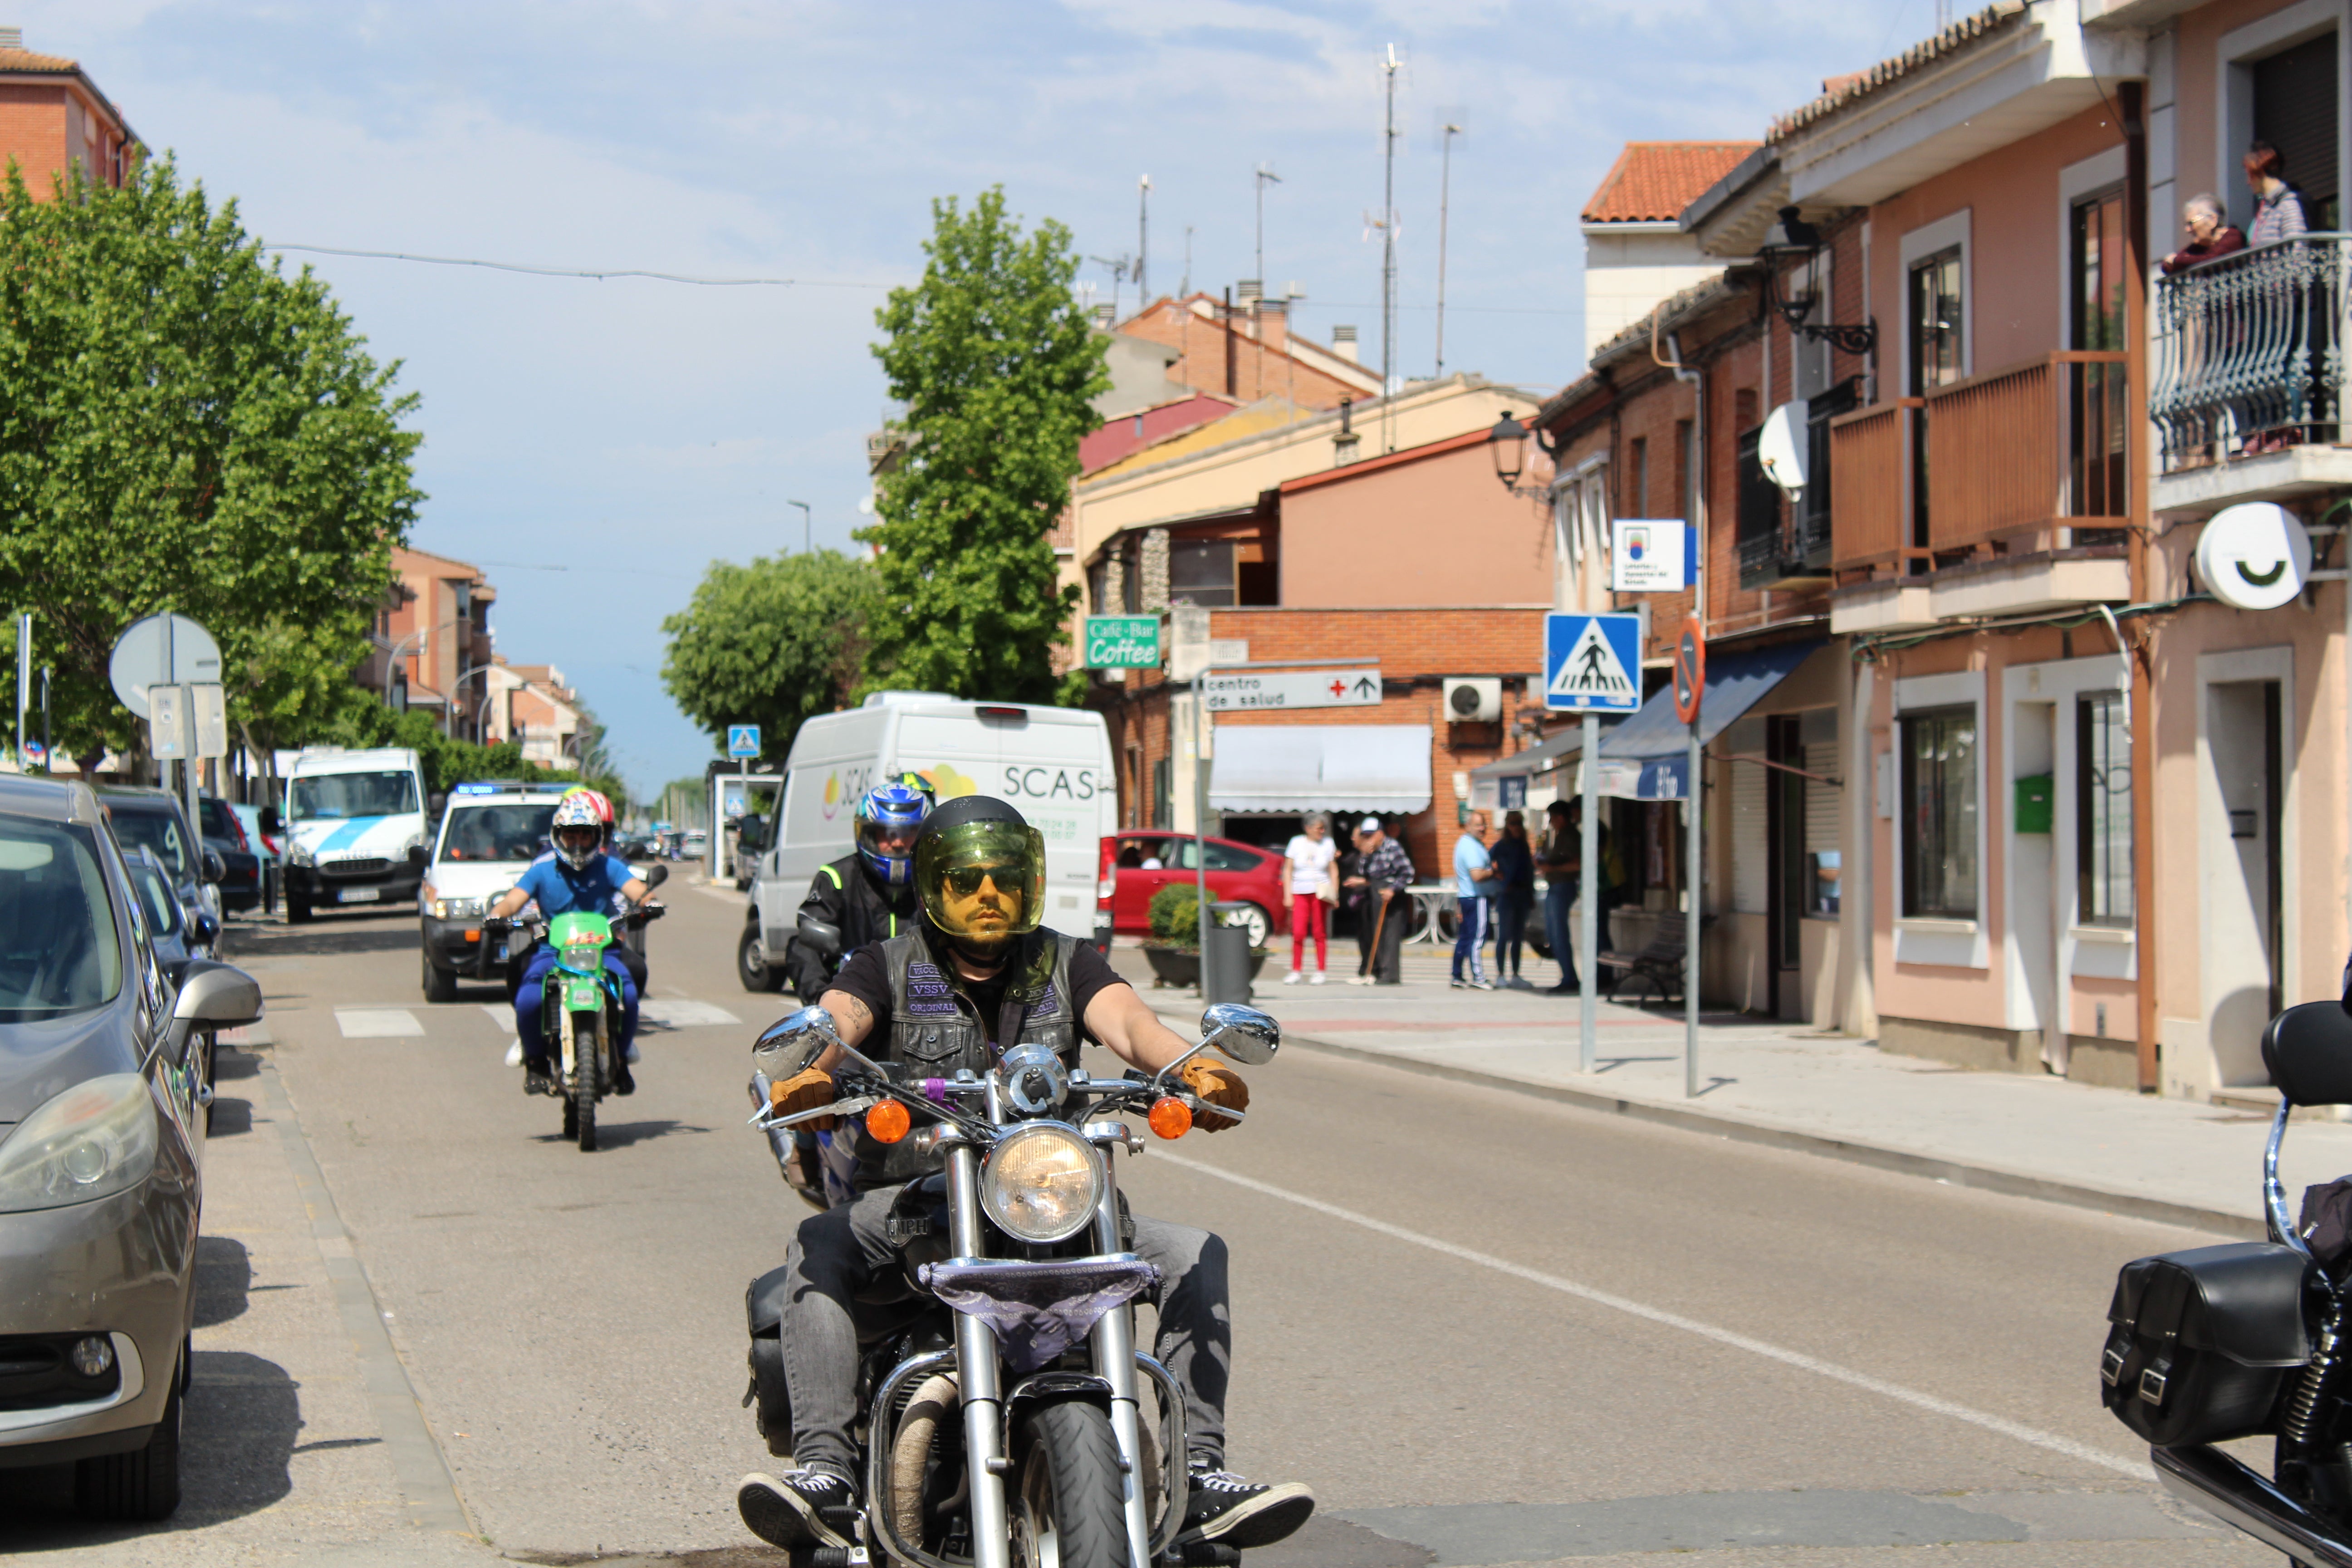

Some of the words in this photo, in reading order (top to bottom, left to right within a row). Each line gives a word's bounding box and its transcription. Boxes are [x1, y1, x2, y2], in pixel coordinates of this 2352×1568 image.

[1090, 639, 1156, 664] Coffee
[1208, 678, 1261, 691] centro
[1209, 696, 1227, 707] de
[1240, 693, 1284, 706] salud
[1004, 767, 1093, 799] SCAS
[913, 985, 948, 994] VSSV
[910, 1003, 955, 1012] ORIGINAL
